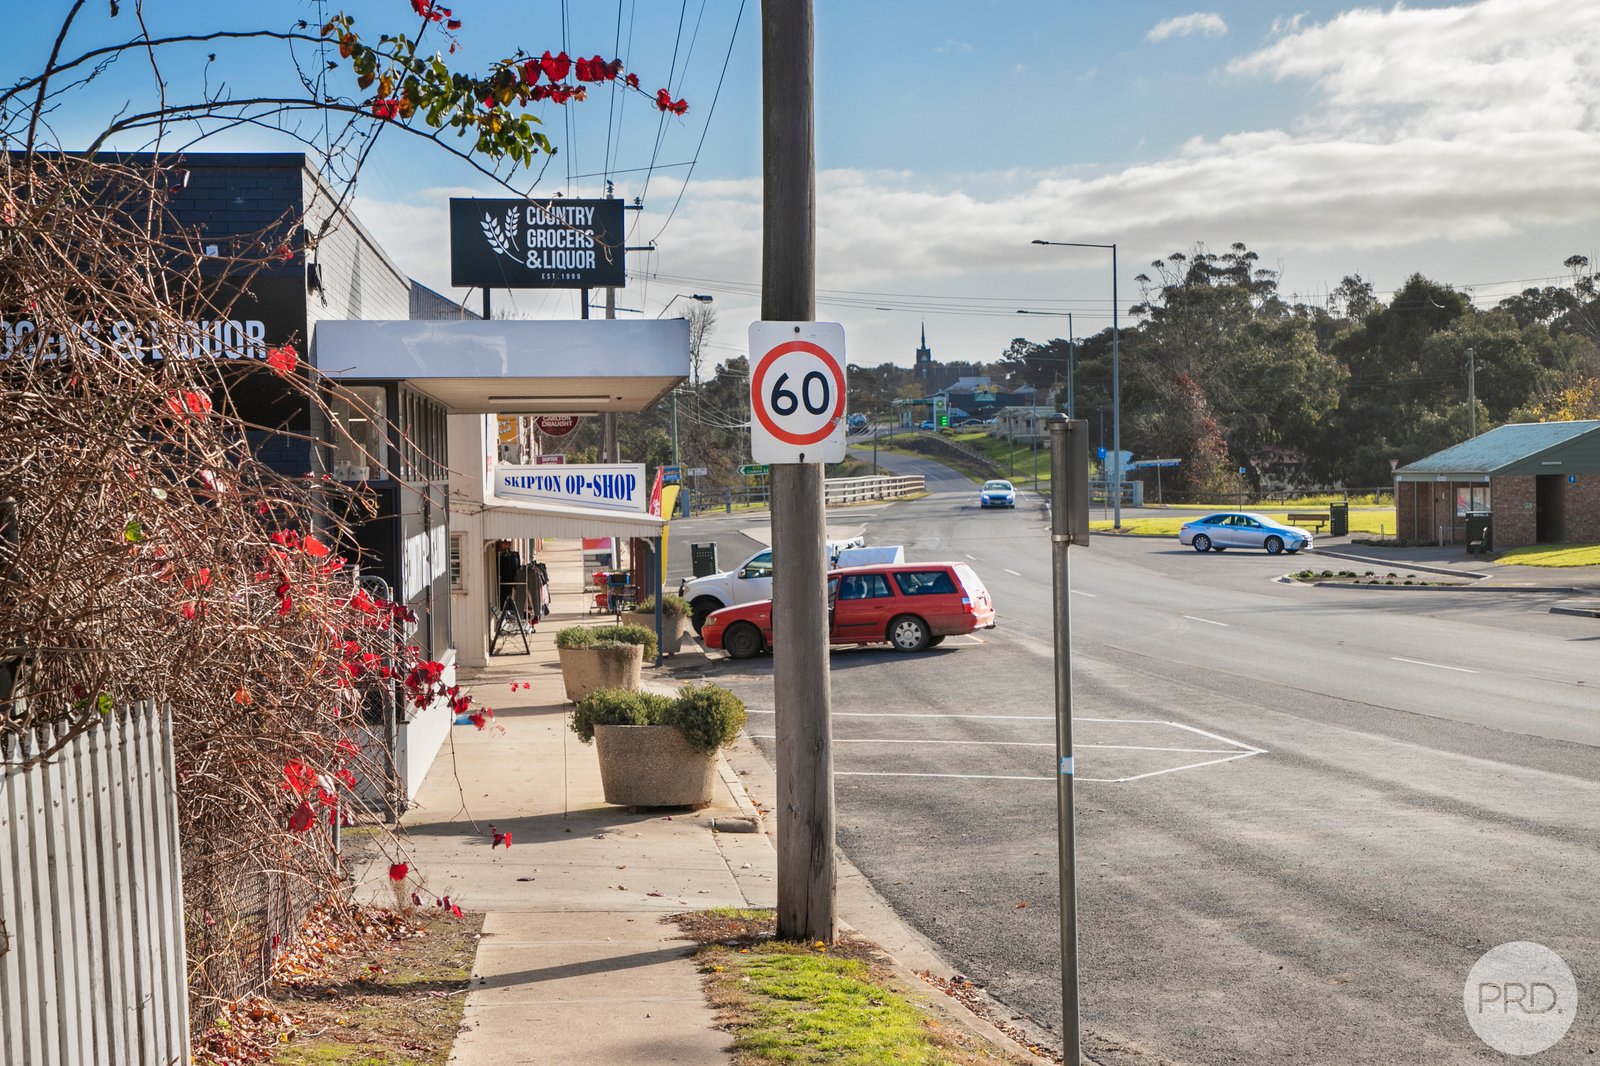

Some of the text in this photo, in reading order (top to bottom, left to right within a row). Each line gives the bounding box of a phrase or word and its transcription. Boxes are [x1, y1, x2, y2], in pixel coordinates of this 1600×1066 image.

[526, 206, 595, 226] COUNTRY
[526, 228, 595, 249] GROCERS
[112, 320, 146, 360] &
[771, 371, 830, 416] 60
[504, 475, 561, 493] SKIPTON
[565, 473, 636, 502] OP-SHOP
